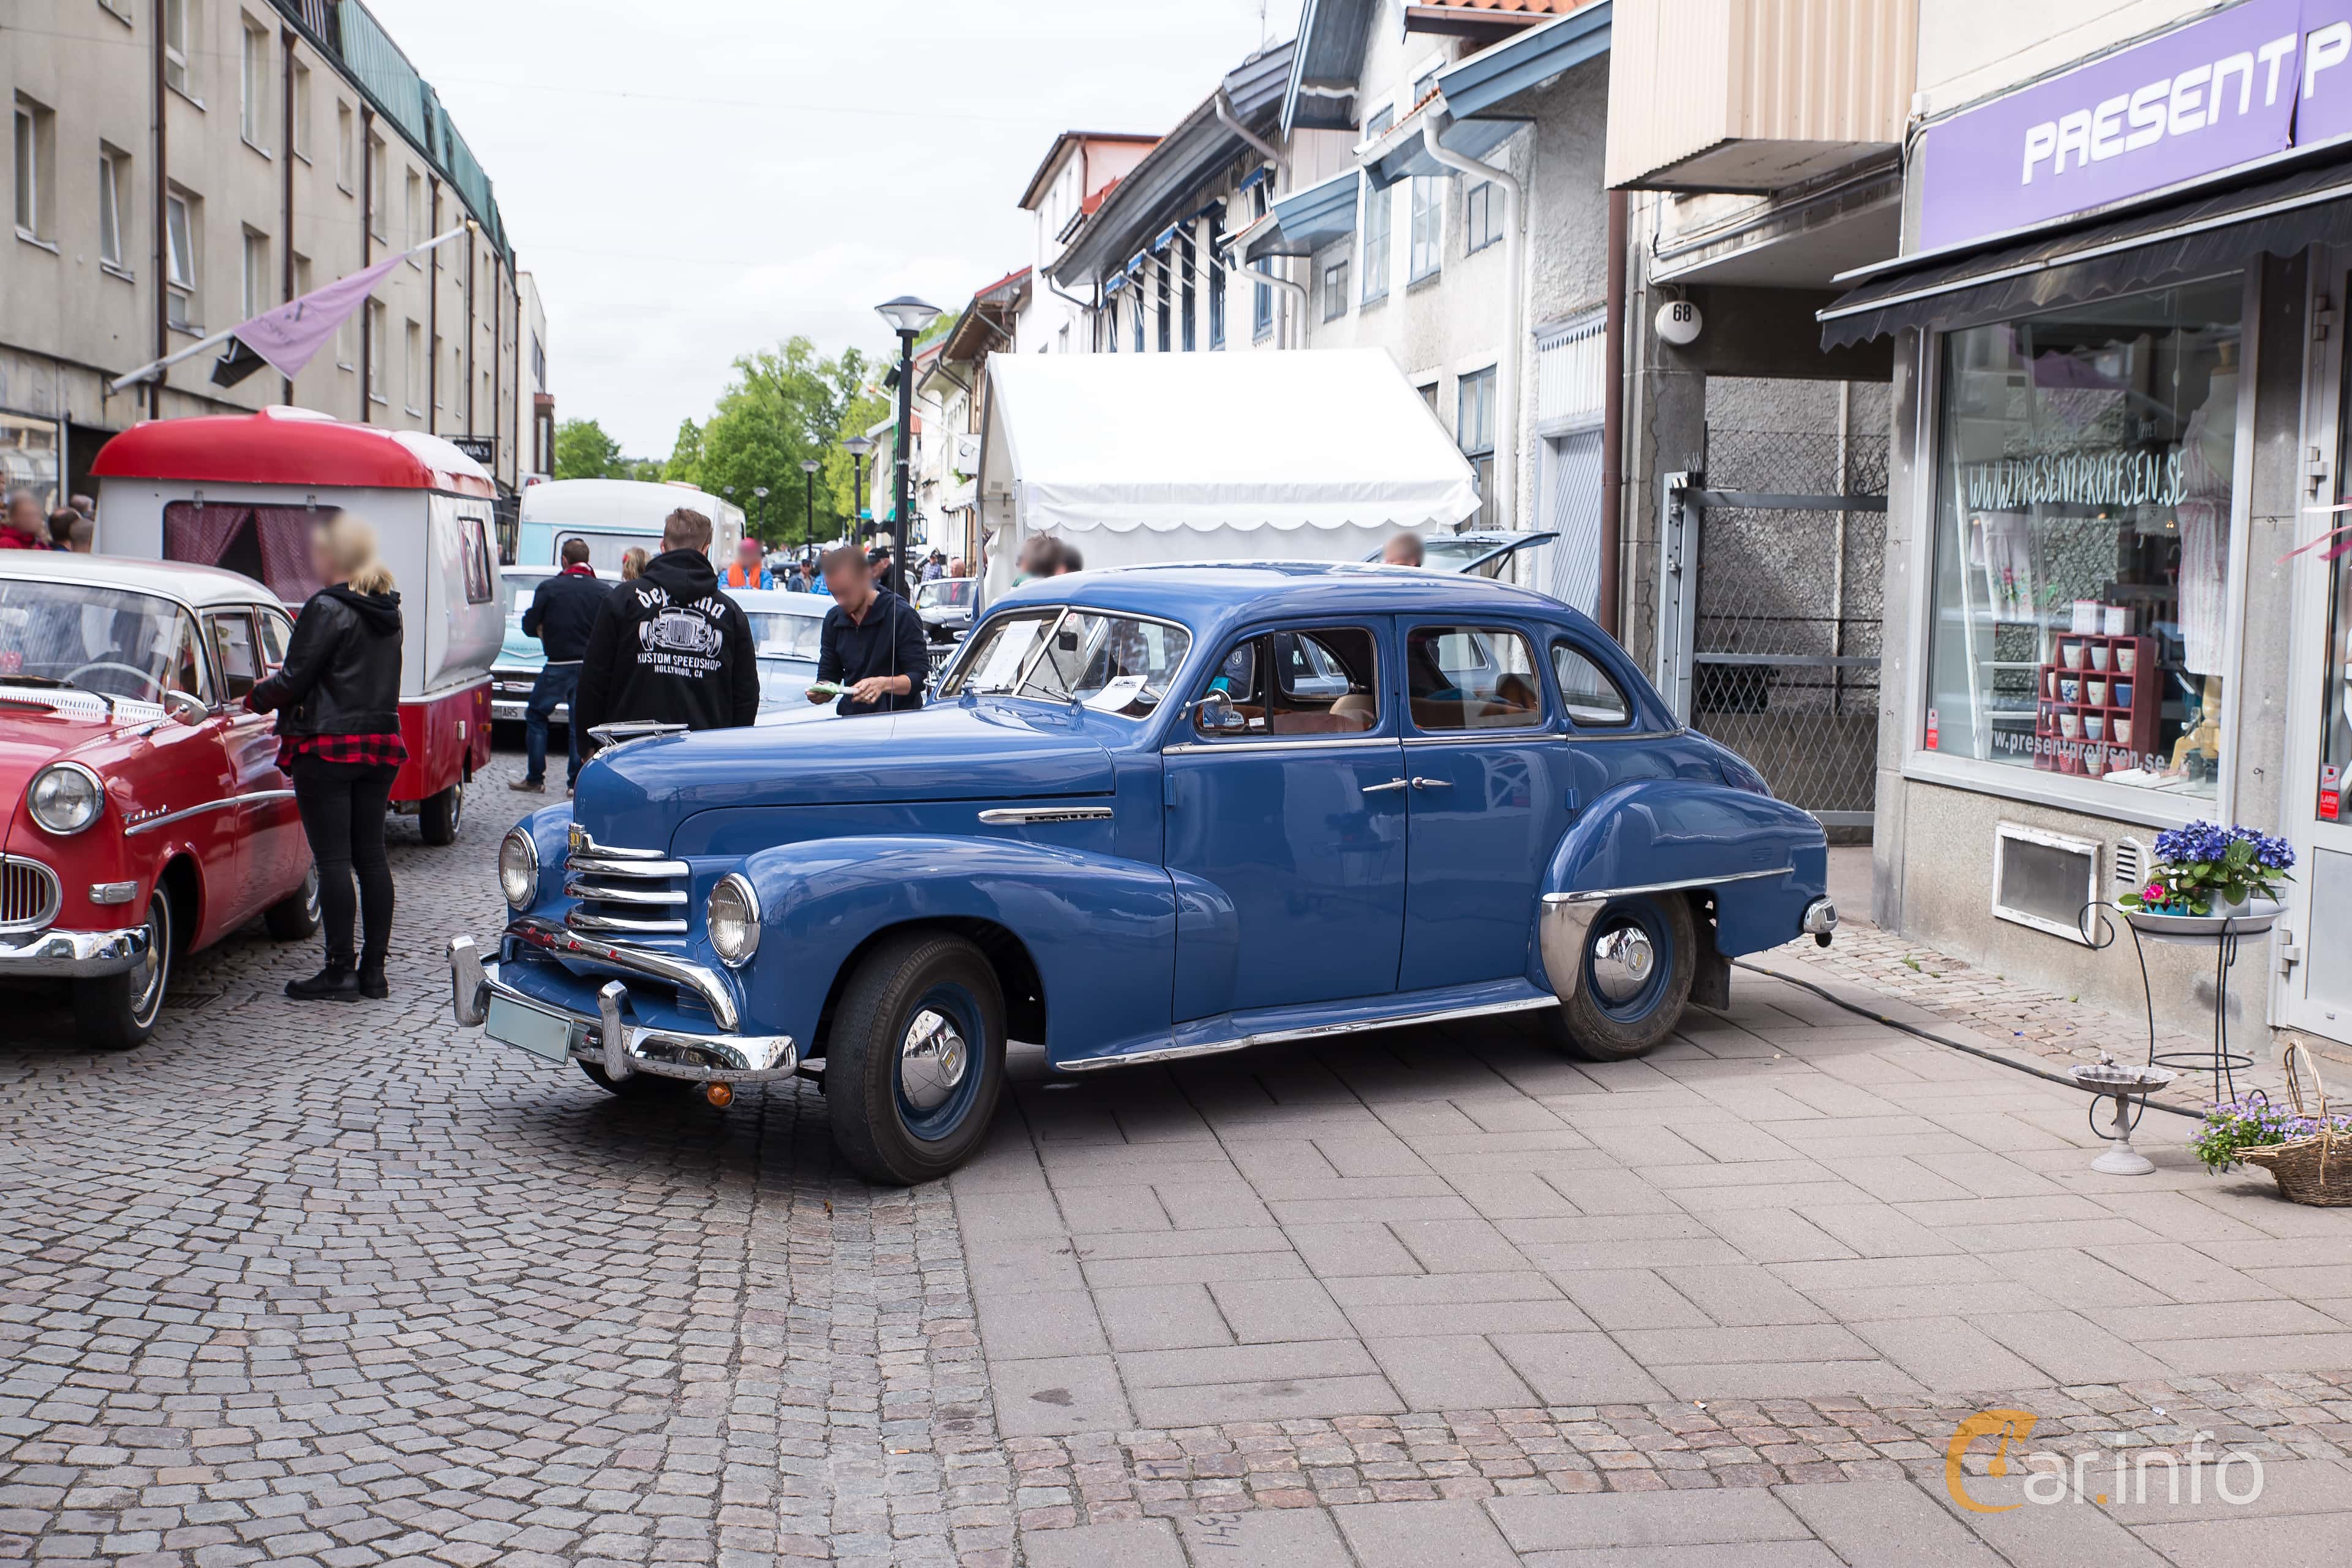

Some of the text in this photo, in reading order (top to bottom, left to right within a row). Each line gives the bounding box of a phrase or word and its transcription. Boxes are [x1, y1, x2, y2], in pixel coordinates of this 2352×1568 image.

[1673, 304, 1691, 322] 68
[1969, 448, 2188, 510] WWW.PRESENTPROFFSEN.SE
[637, 652, 722, 671] KUSTOM SPEEDSHOP
[654, 665, 703, 679] HOLLYWOOD, CA
